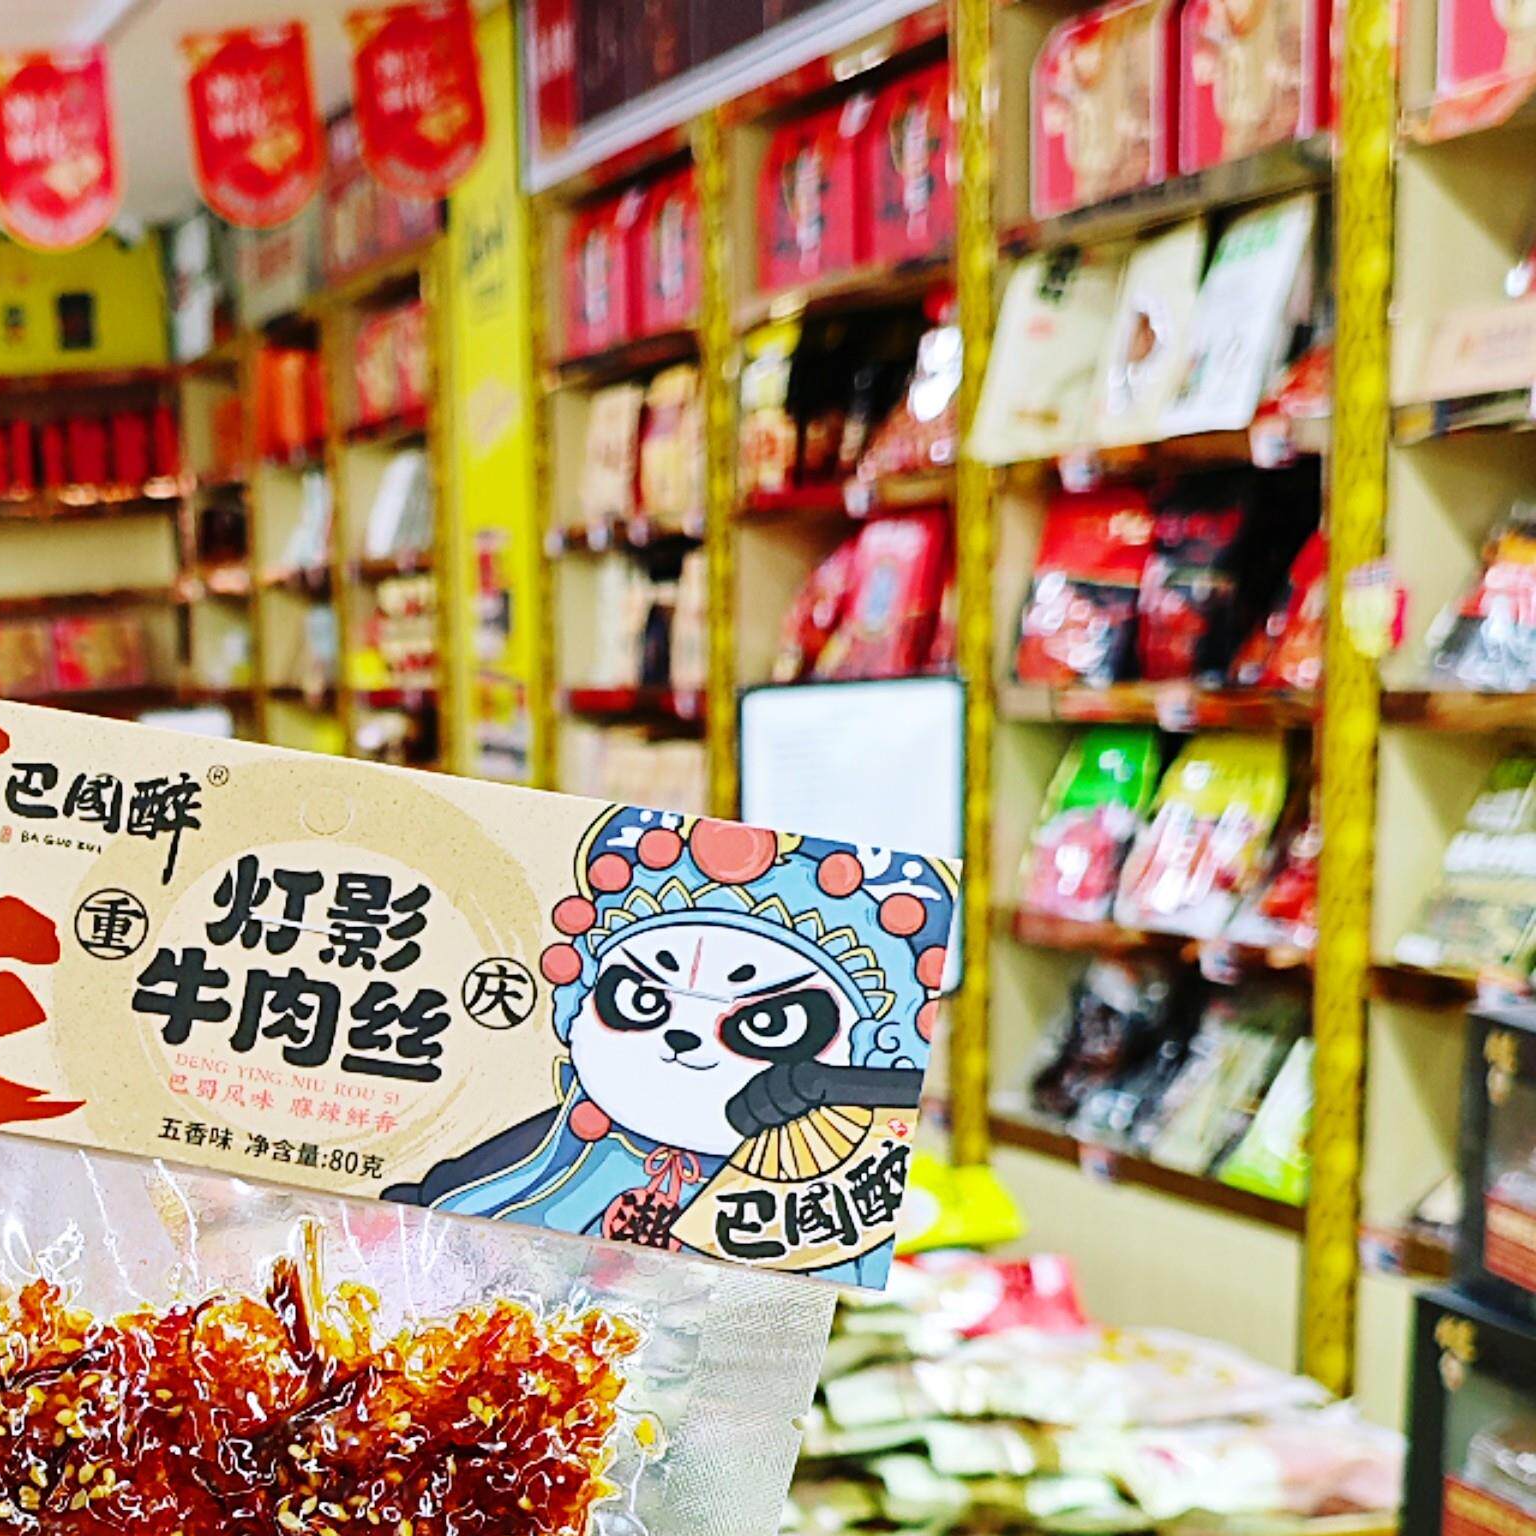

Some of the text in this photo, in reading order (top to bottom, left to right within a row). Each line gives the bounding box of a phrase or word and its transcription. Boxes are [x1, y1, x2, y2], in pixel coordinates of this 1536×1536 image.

[75, 890, 149, 959] 重
[205, 853, 432, 972] 灯影
[132, 947, 452, 1083] 牛肉丝
[463, 959, 535, 1029] 庆
[168, 1073, 398, 1134] 巴蜀风味 麻辣鲜香
[175, 1052, 400, 1105] DENG YING NIU ROU SI
[158, 1117, 386, 1179] 五香味 净含量:80克
